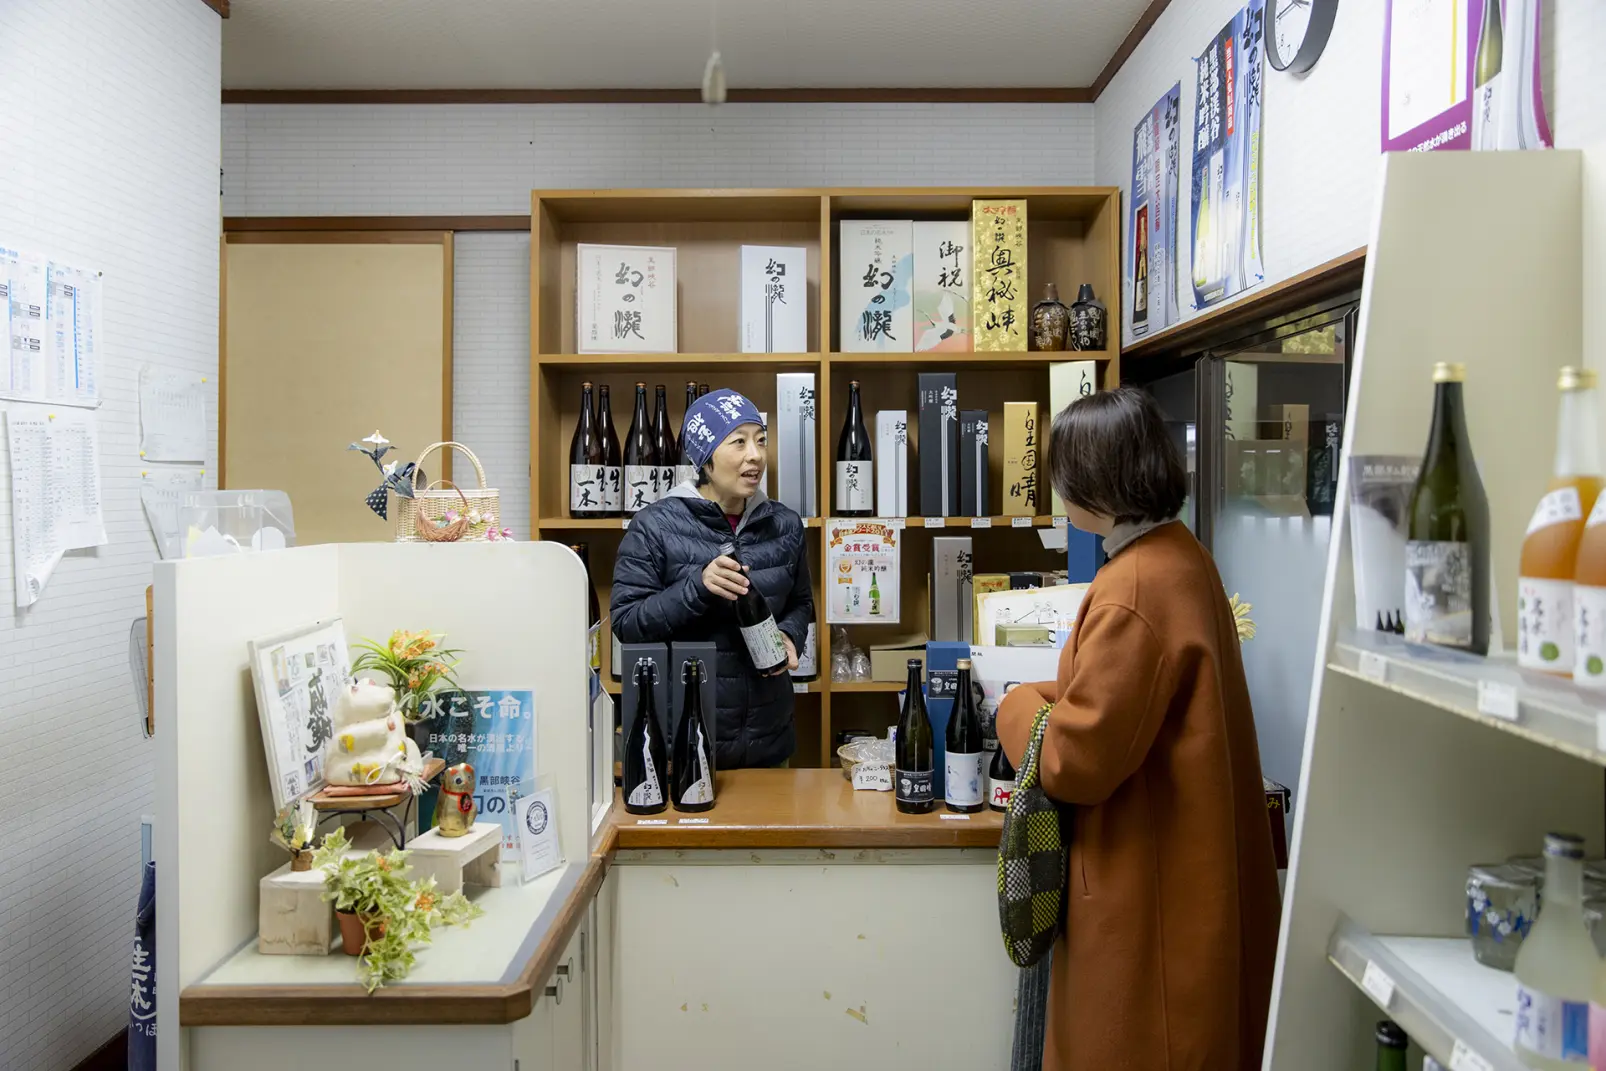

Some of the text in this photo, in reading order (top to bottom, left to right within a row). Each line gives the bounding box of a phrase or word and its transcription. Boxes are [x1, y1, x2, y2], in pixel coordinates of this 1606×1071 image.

[765, 258, 787, 305] 幻の瀧
[937, 240, 964, 289] 御祝
[614, 262, 645, 340] 幻の瀧
[862, 263, 897, 341] 幻の瀧
[843, 543, 880, 552] 金賞受賞
[304, 667, 334, 754] 感謝
[422, 695, 532, 720] 水こそ命。
[479, 775, 522, 787] 黒部峡谷
